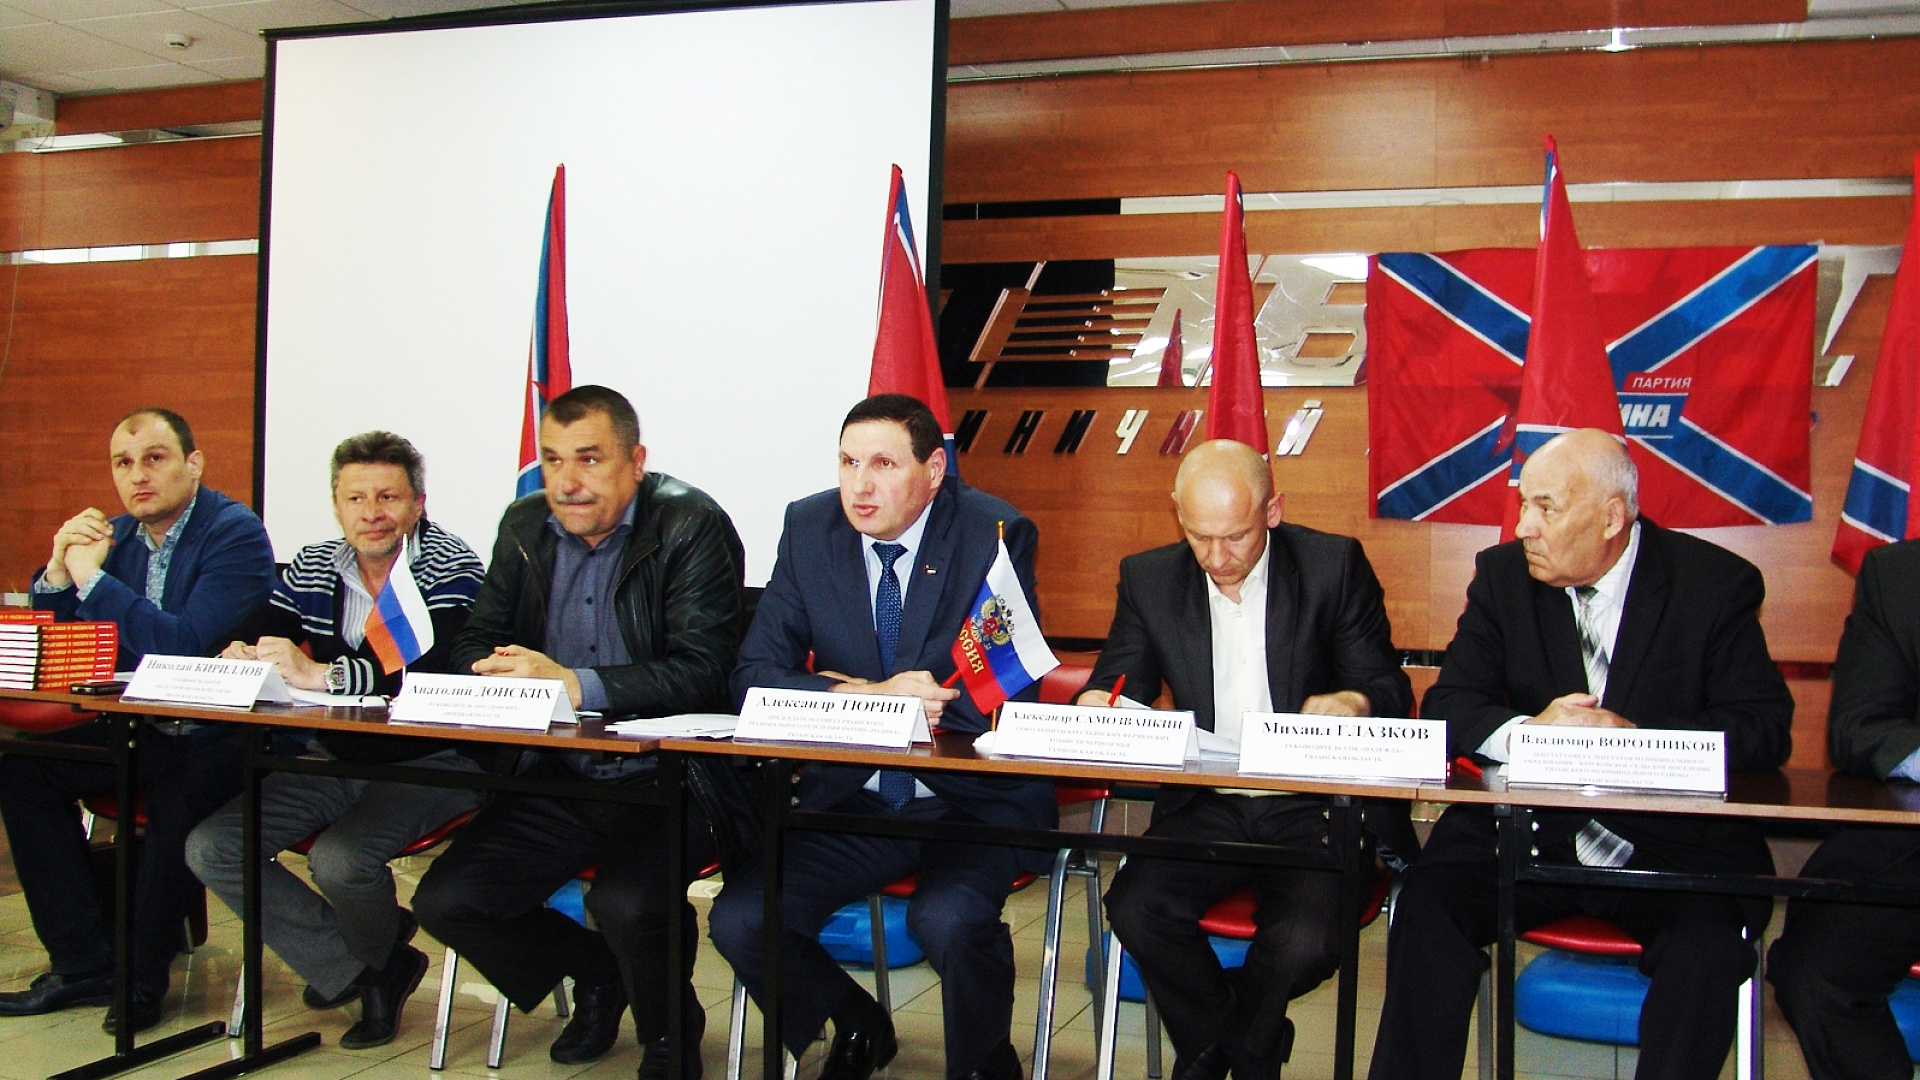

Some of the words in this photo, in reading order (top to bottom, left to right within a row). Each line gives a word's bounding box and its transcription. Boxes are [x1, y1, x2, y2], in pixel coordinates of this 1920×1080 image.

[1632, 377, 1692, 388] ПАРТИЯ
[1619, 403, 1671, 428] ИНА
[959, 627, 985, 675] ССИЯ
[147, 660, 192, 672] Николай
[194, 662, 264, 677] КИРИЛЛОВ
[408, 684, 474, 697] Анатолий
[475, 685, 554, 700] ДОНСКИХ
[756, 695, 836, 713] Александр
[841, 699, 906, 714] ТЮРИН
[1010, 711, 1072, 724] Александр
[1075, 714, 1183, 729] САМОЗВАНКИН
[1262, 721, 1331, 736] Михаил
[1337, 724, 1430, 740] ГЛАЗКОВ
[1521, 733, 1594, 749] Владимир
[1598, 737, 1717, 752] ВОРОТНИКОВ
